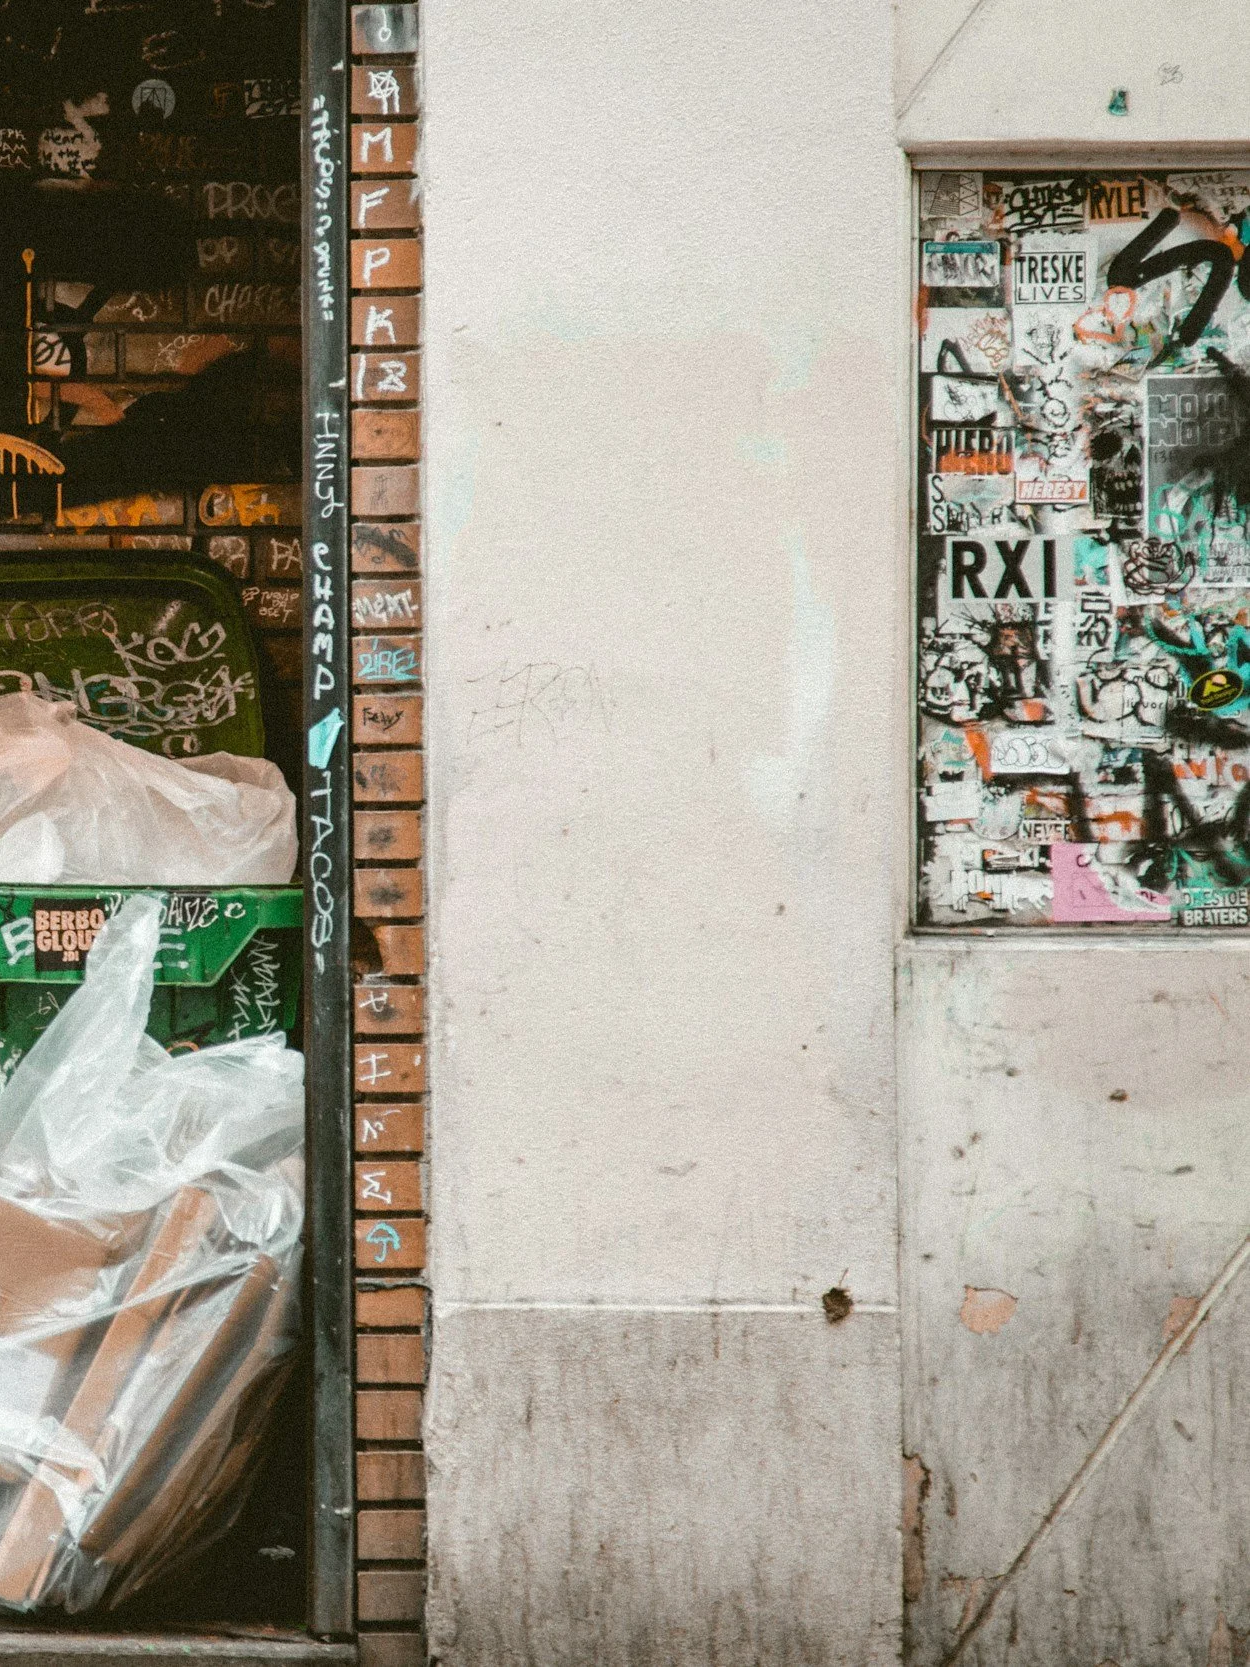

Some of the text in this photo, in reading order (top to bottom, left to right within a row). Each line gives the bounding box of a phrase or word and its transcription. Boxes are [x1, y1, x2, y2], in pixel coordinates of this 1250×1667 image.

[1016, 254, 1084, 284] TRESKE
[1017, 286, 1084, 301] LIVES
[1020, 482, 1084, 499] HERESY
[1126, 697, 1164, 709] liuor
[35, 908, 105, 931] BERBO
[1183, 908, 1248, 926] BRATERS
